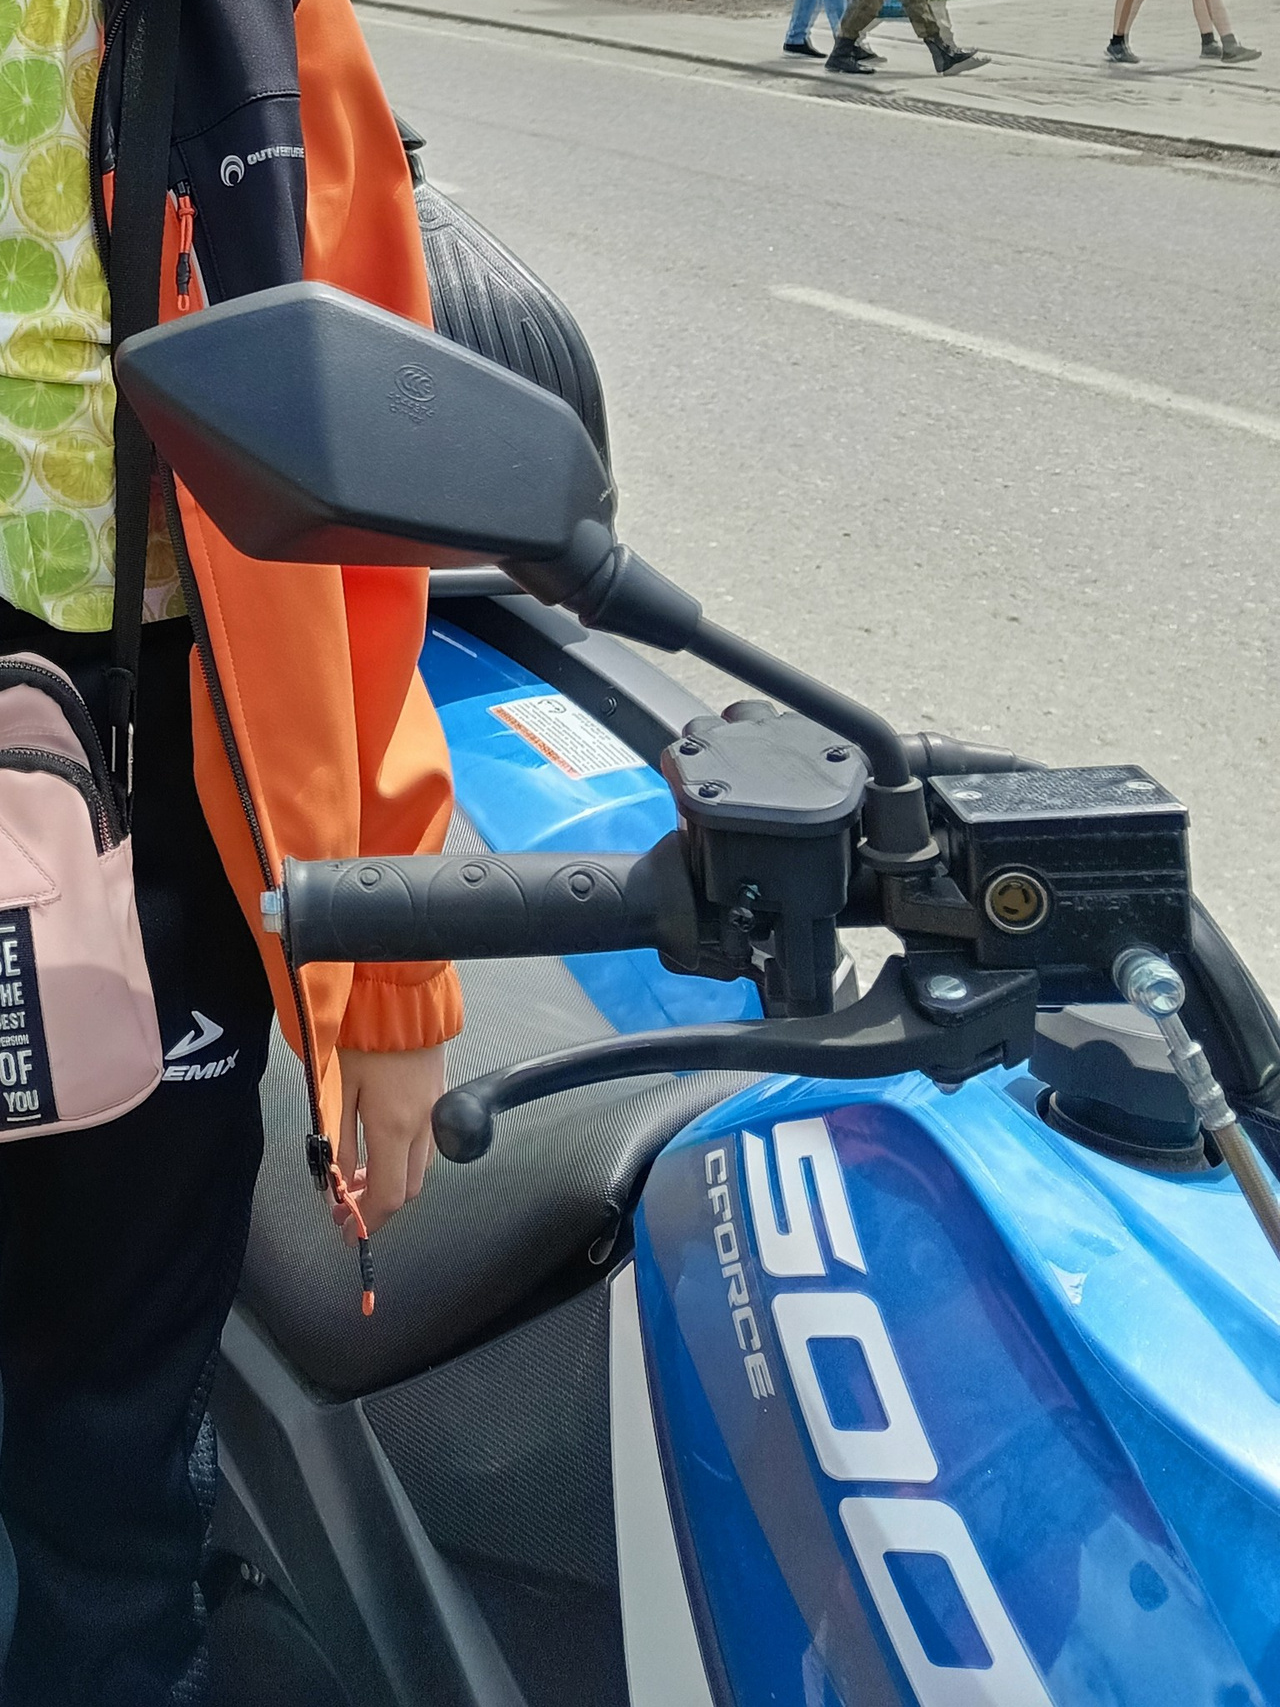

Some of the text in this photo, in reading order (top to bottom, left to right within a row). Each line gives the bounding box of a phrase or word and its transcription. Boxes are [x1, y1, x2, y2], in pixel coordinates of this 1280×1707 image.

[3, 1089, 39, 1113] YOU
[161, 1048, 239, 1081] EMIX
[704, 1147, 776, 1401] CFORCE
[742, 1117, 1059, 1707] 500
